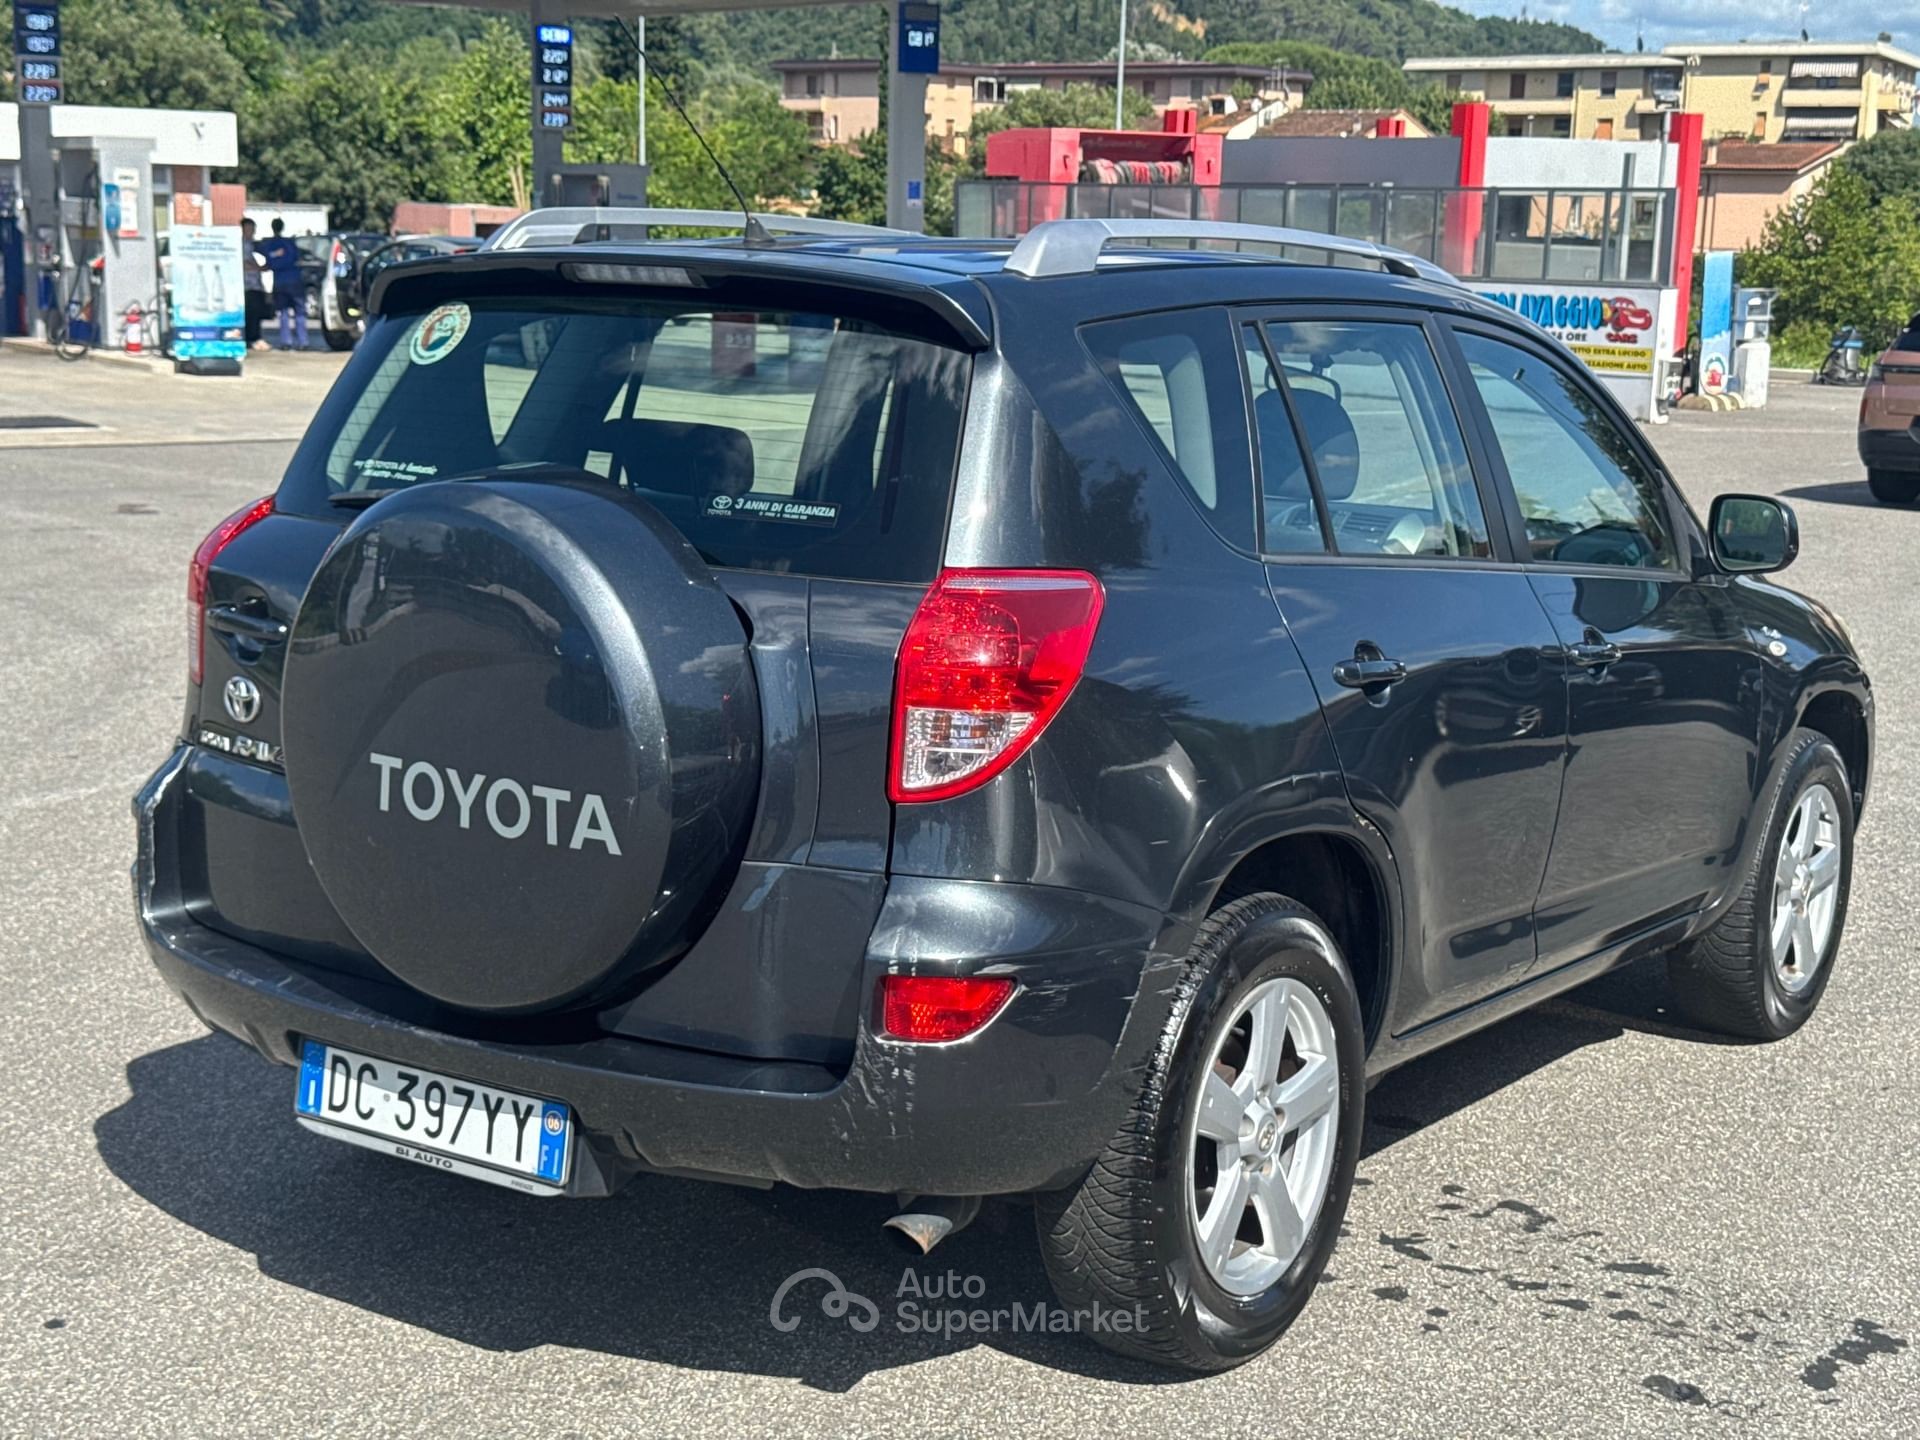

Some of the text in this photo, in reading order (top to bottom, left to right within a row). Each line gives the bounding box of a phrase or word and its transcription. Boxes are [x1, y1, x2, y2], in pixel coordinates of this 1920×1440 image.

[1566, 332, 1588, 341] ORE
[1593, 348, 1616, 356] EXTRA
[734, 498, 744, 509] 3
[743, 500, 770, 511] ANNI
[771, 502, 784, 512] DI
[784, 503, 836, 518] GARANZIA
[369, 752, 623, 856] TOYOTA
[328, 1053, 535, 1163] DC 397YY
[395, 1146, 453, 1169] BI AUTO
